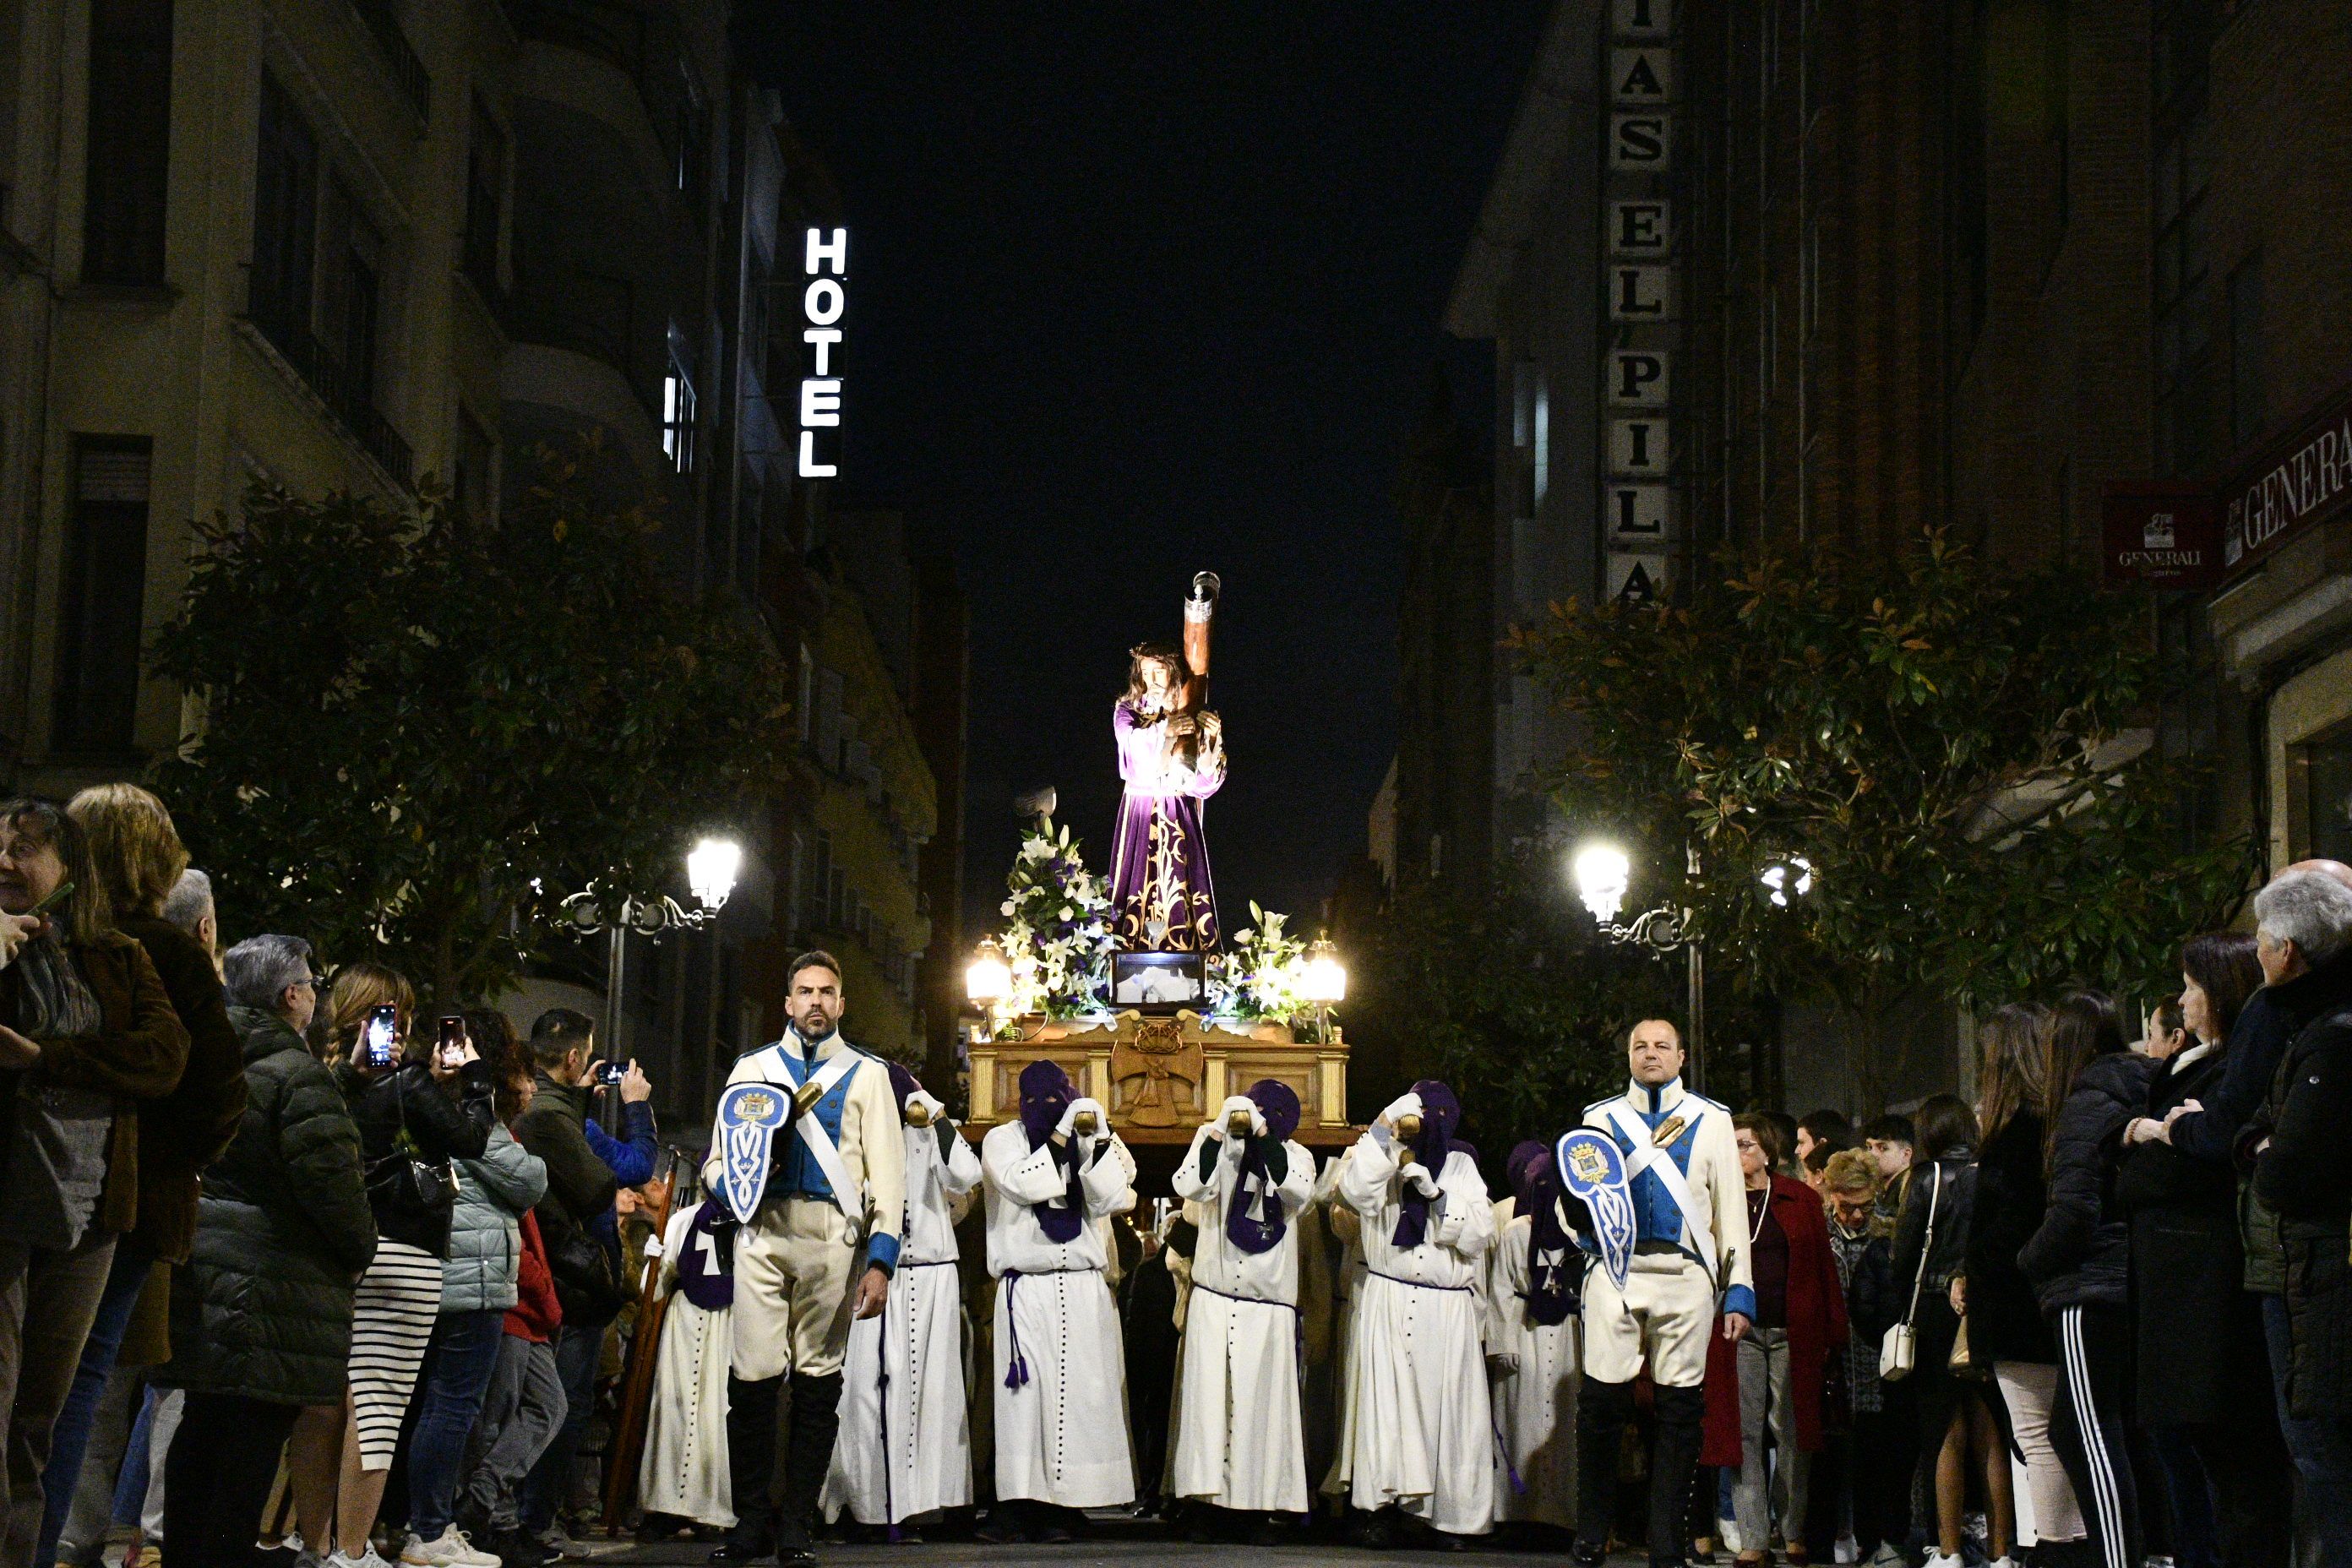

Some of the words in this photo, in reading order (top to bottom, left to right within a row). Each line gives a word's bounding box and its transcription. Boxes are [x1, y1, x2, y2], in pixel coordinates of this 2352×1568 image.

[1620, 205, 1662, 313] EL
[799, 228, 847, 477] HOTEL
[2119, 551, 2201, 566] GENERALI
